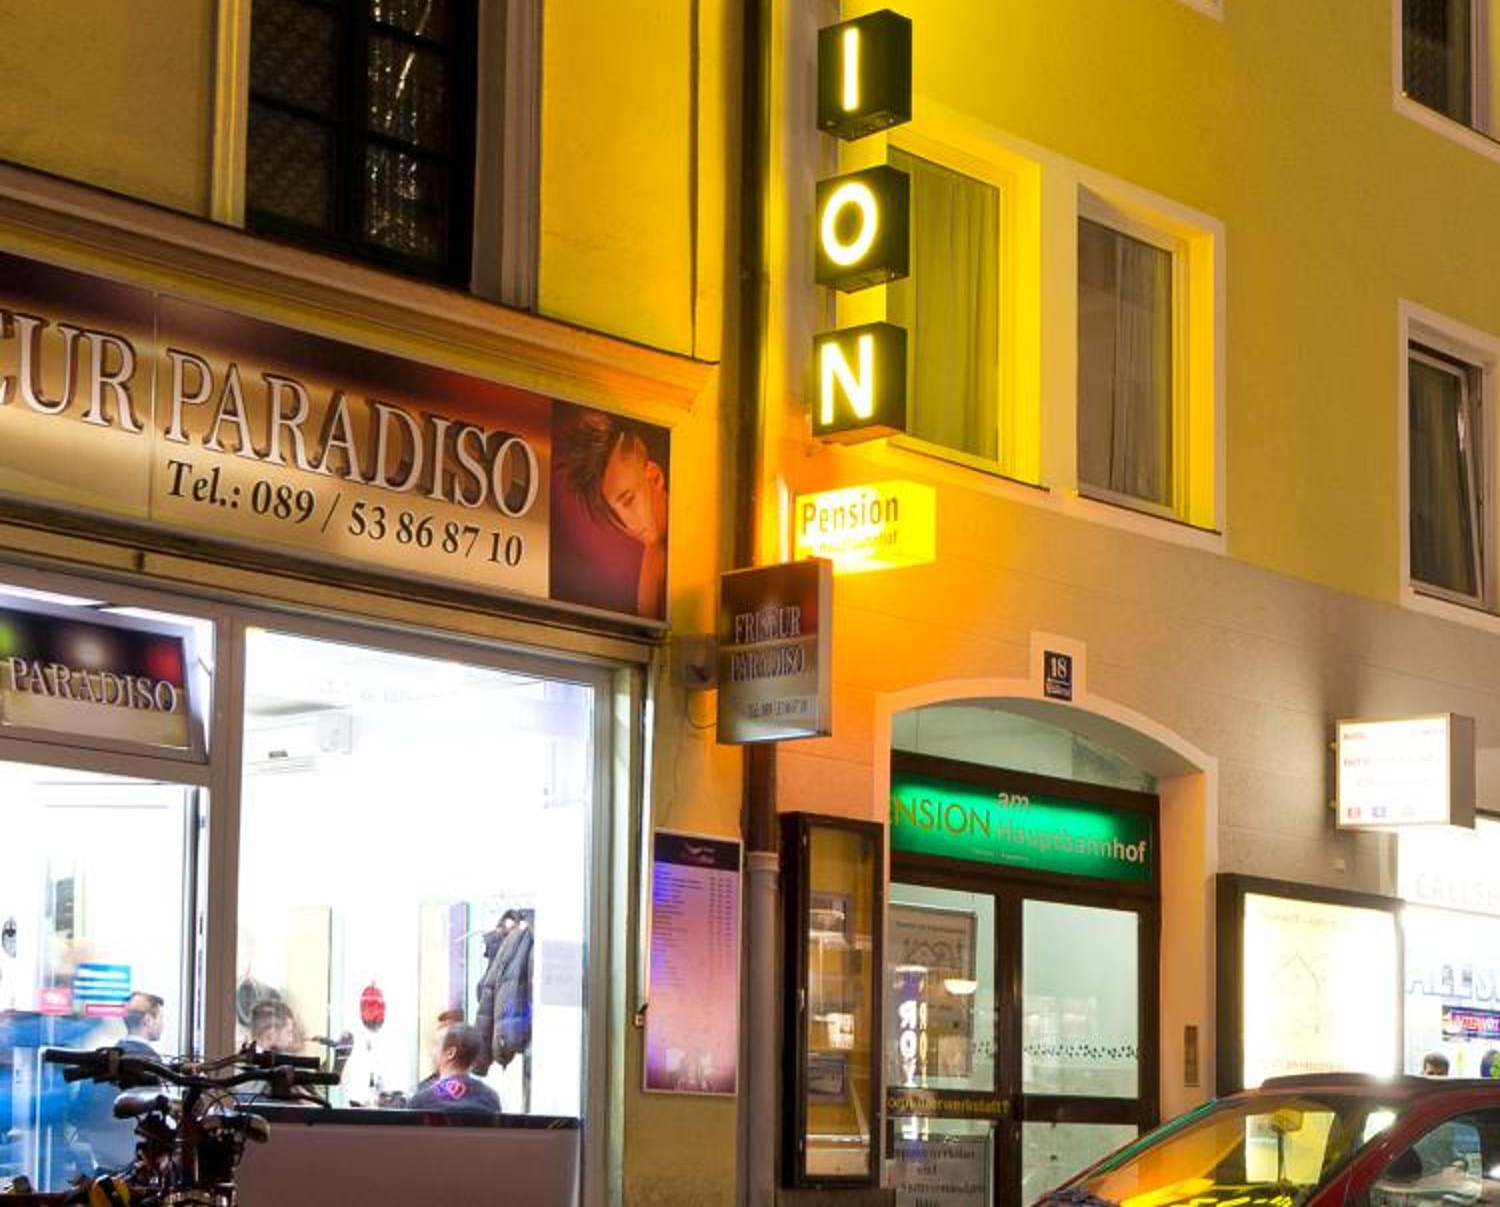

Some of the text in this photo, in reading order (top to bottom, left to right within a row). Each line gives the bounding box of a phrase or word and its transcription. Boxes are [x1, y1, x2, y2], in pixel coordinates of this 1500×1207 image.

[0, 308, 540, 519] UR PARADISO
[168, 459, 241, 509] Tel.:
[251, 479, 315, 524] 089
[348, 501, 386, 540] 53
[396, 511, 434, 548] 86
[442, 520, 480, 558] 87
[487, 531, 523, 567] 10
[802, 493, 899, 536] Pension
[8, 656, 178, 714] PARADISO
[1051, 656, 1067, 679] 18
[891, 796, 991, 837] NSION
[997, 793, 1030, 809] am
[998, 820, 1147, 864] Hauptbahnhof
